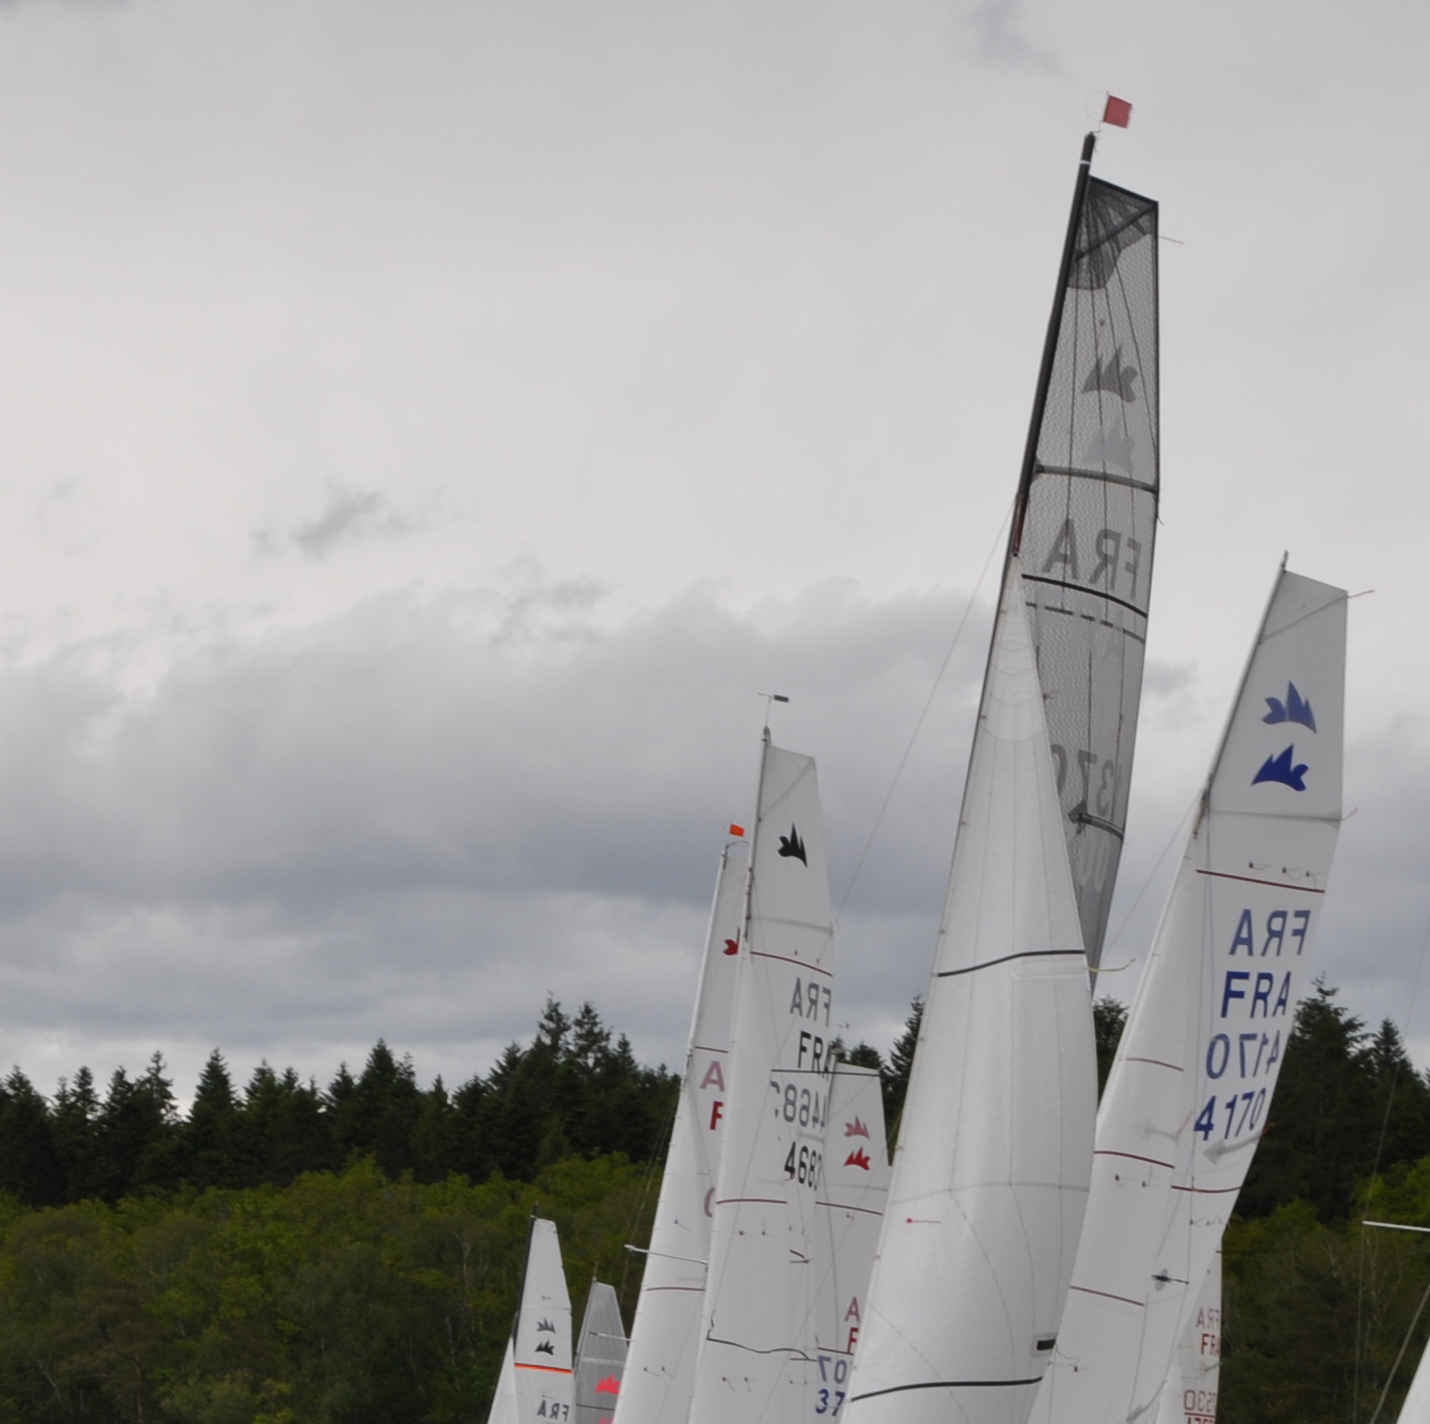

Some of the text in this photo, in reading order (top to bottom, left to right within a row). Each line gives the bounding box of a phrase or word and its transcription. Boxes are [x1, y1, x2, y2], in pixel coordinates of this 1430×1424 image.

[1220, 970, 1291, 1018] FRA
[797, 1030, 832, 1081] FRA
[1193, 1087, 1267, 1141] 4170
